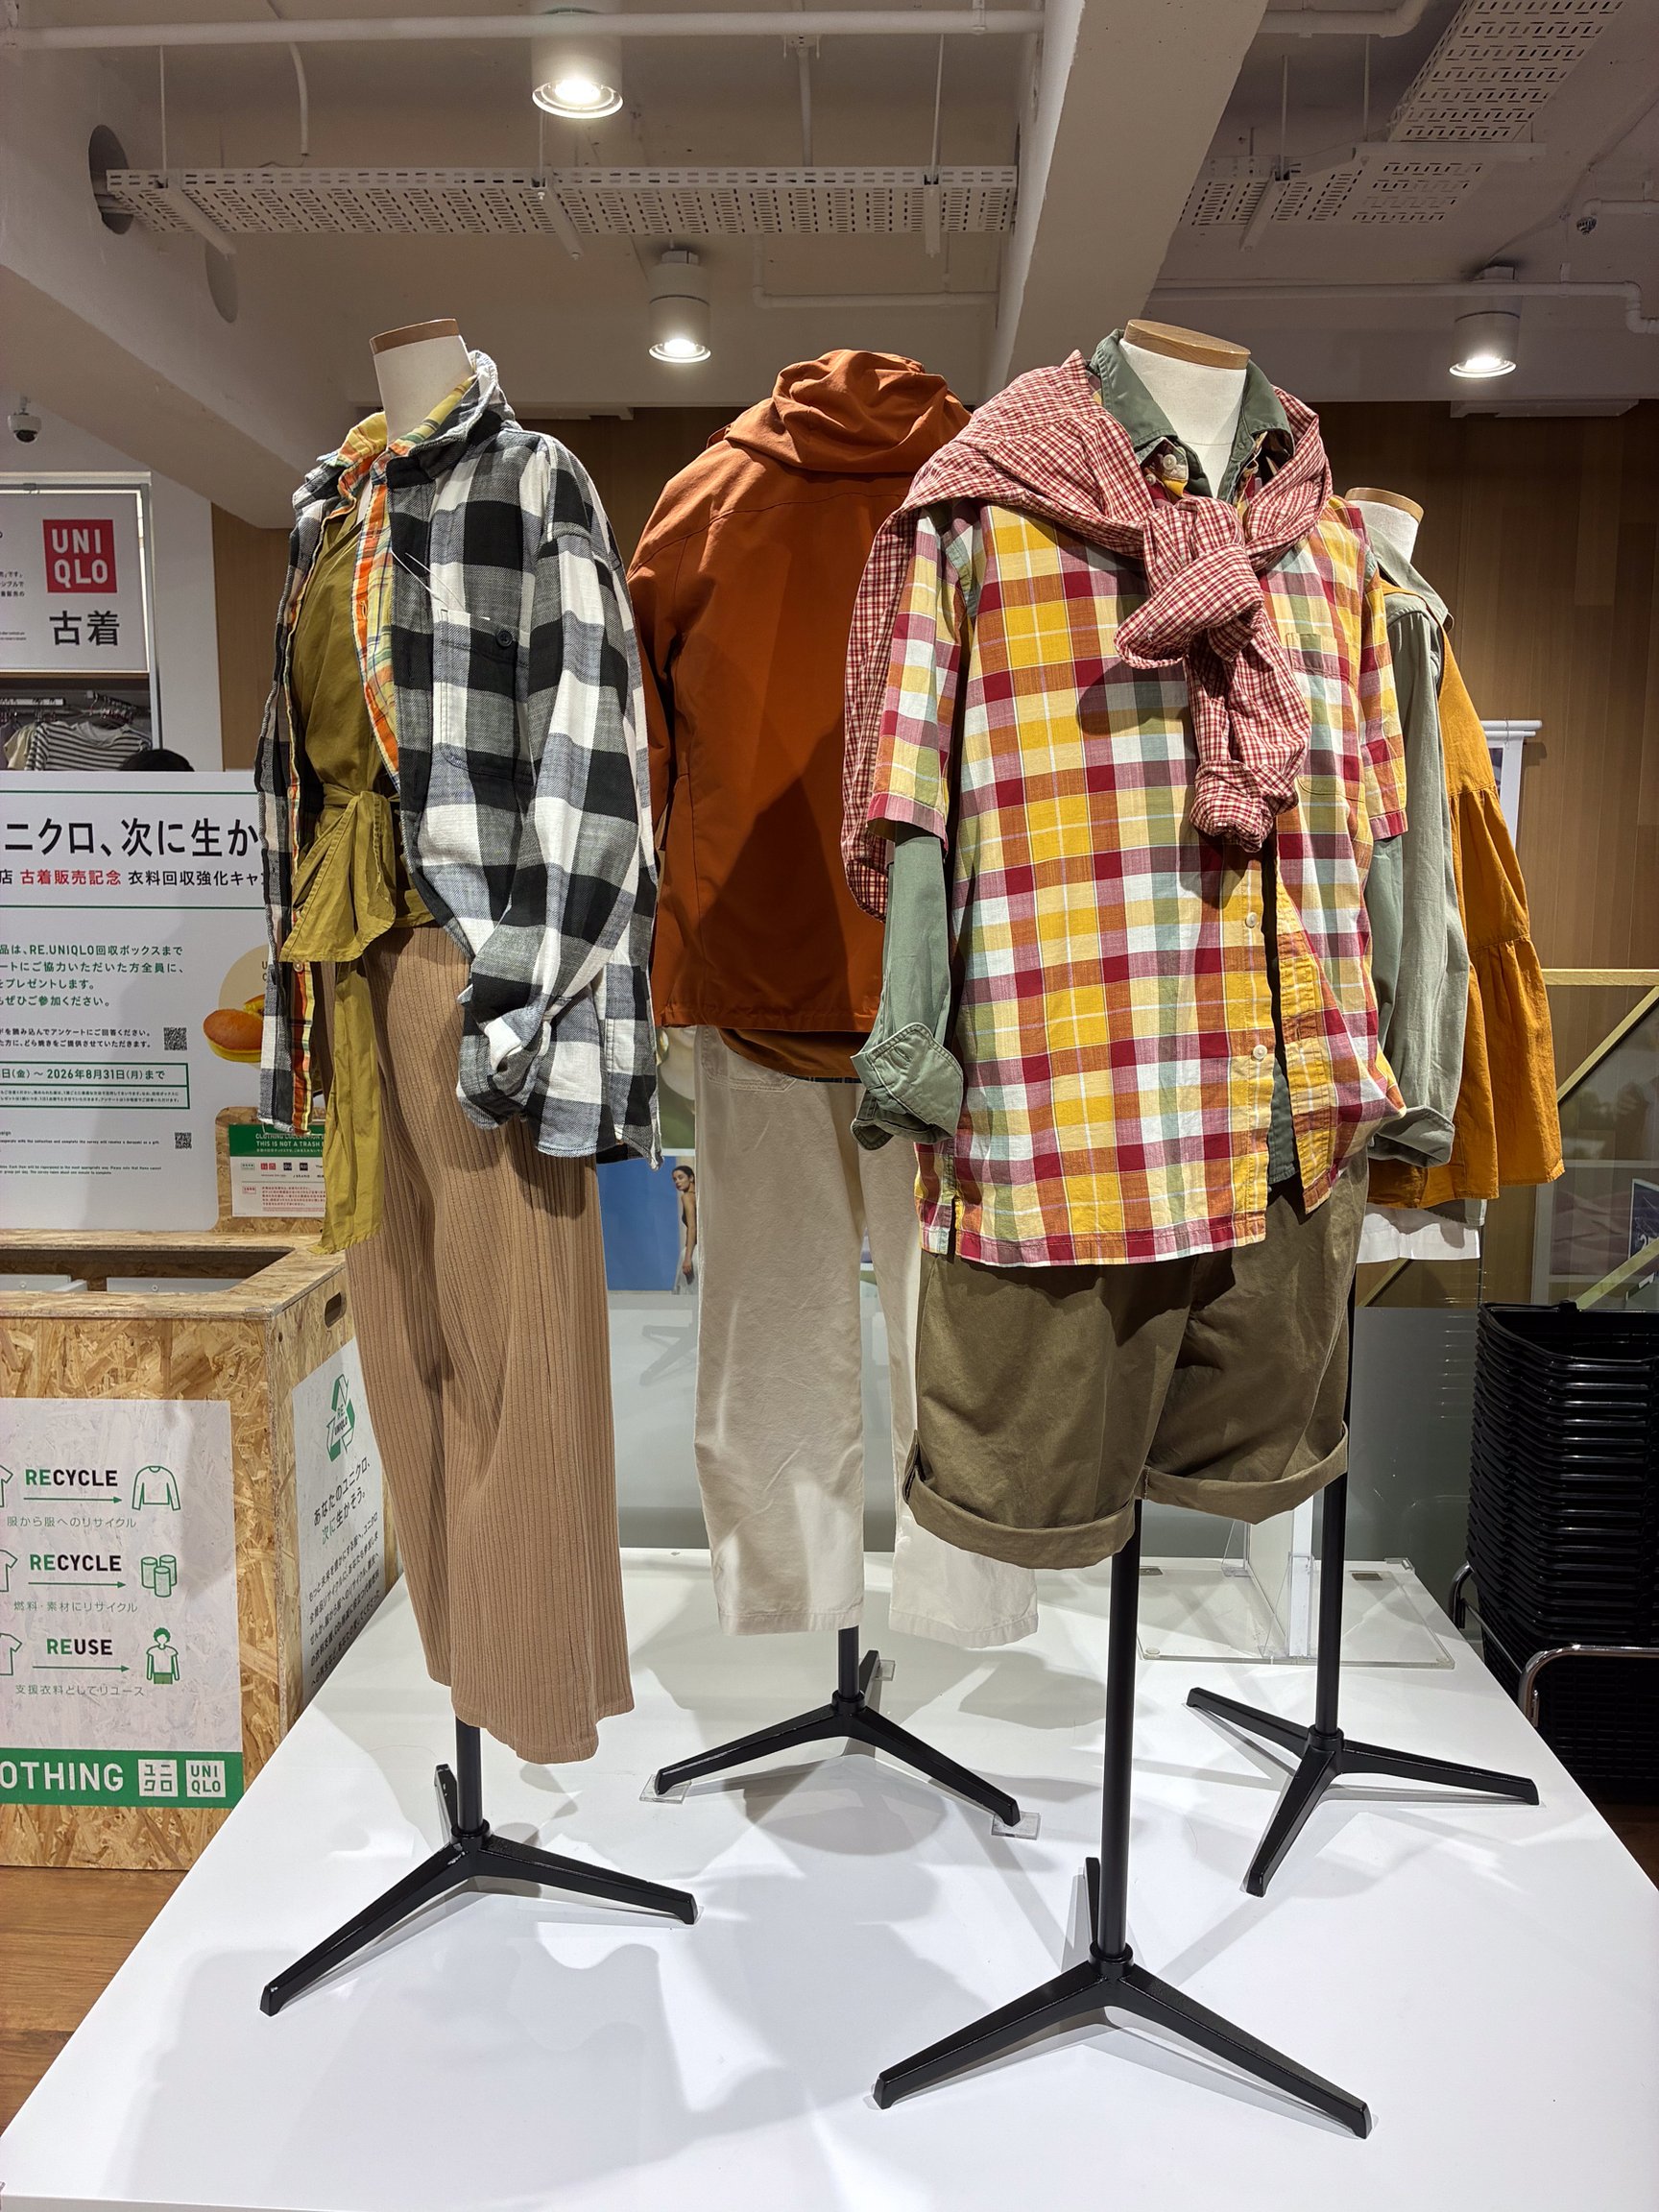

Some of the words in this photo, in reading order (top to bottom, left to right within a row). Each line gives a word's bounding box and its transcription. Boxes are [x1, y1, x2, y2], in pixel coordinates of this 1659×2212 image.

[52, 529, 101, 554] UNI
[54, 559, 108, 589] QLO
[50, 611, 120, 646] 古着
[5, 817, 258, 857] ニクロ、次に生か
[20, 869, 122, 886] 古着販売記念
[128, 870, 264, 886] 衣料回収強化キャ
[25, 1469, 118, 1486] RECYCLE
[7, 1516, 137, 1527] 服から服へのリサイクル
[30, 1554, 122, 1572] RECYCLE
[46, 1638, 113, 1655] REUSE
[0, 1761, 124, 1791] OTHING
[190, 1765, 218, 1777] UNI
[191, 1780, 221, 1794] QLO
